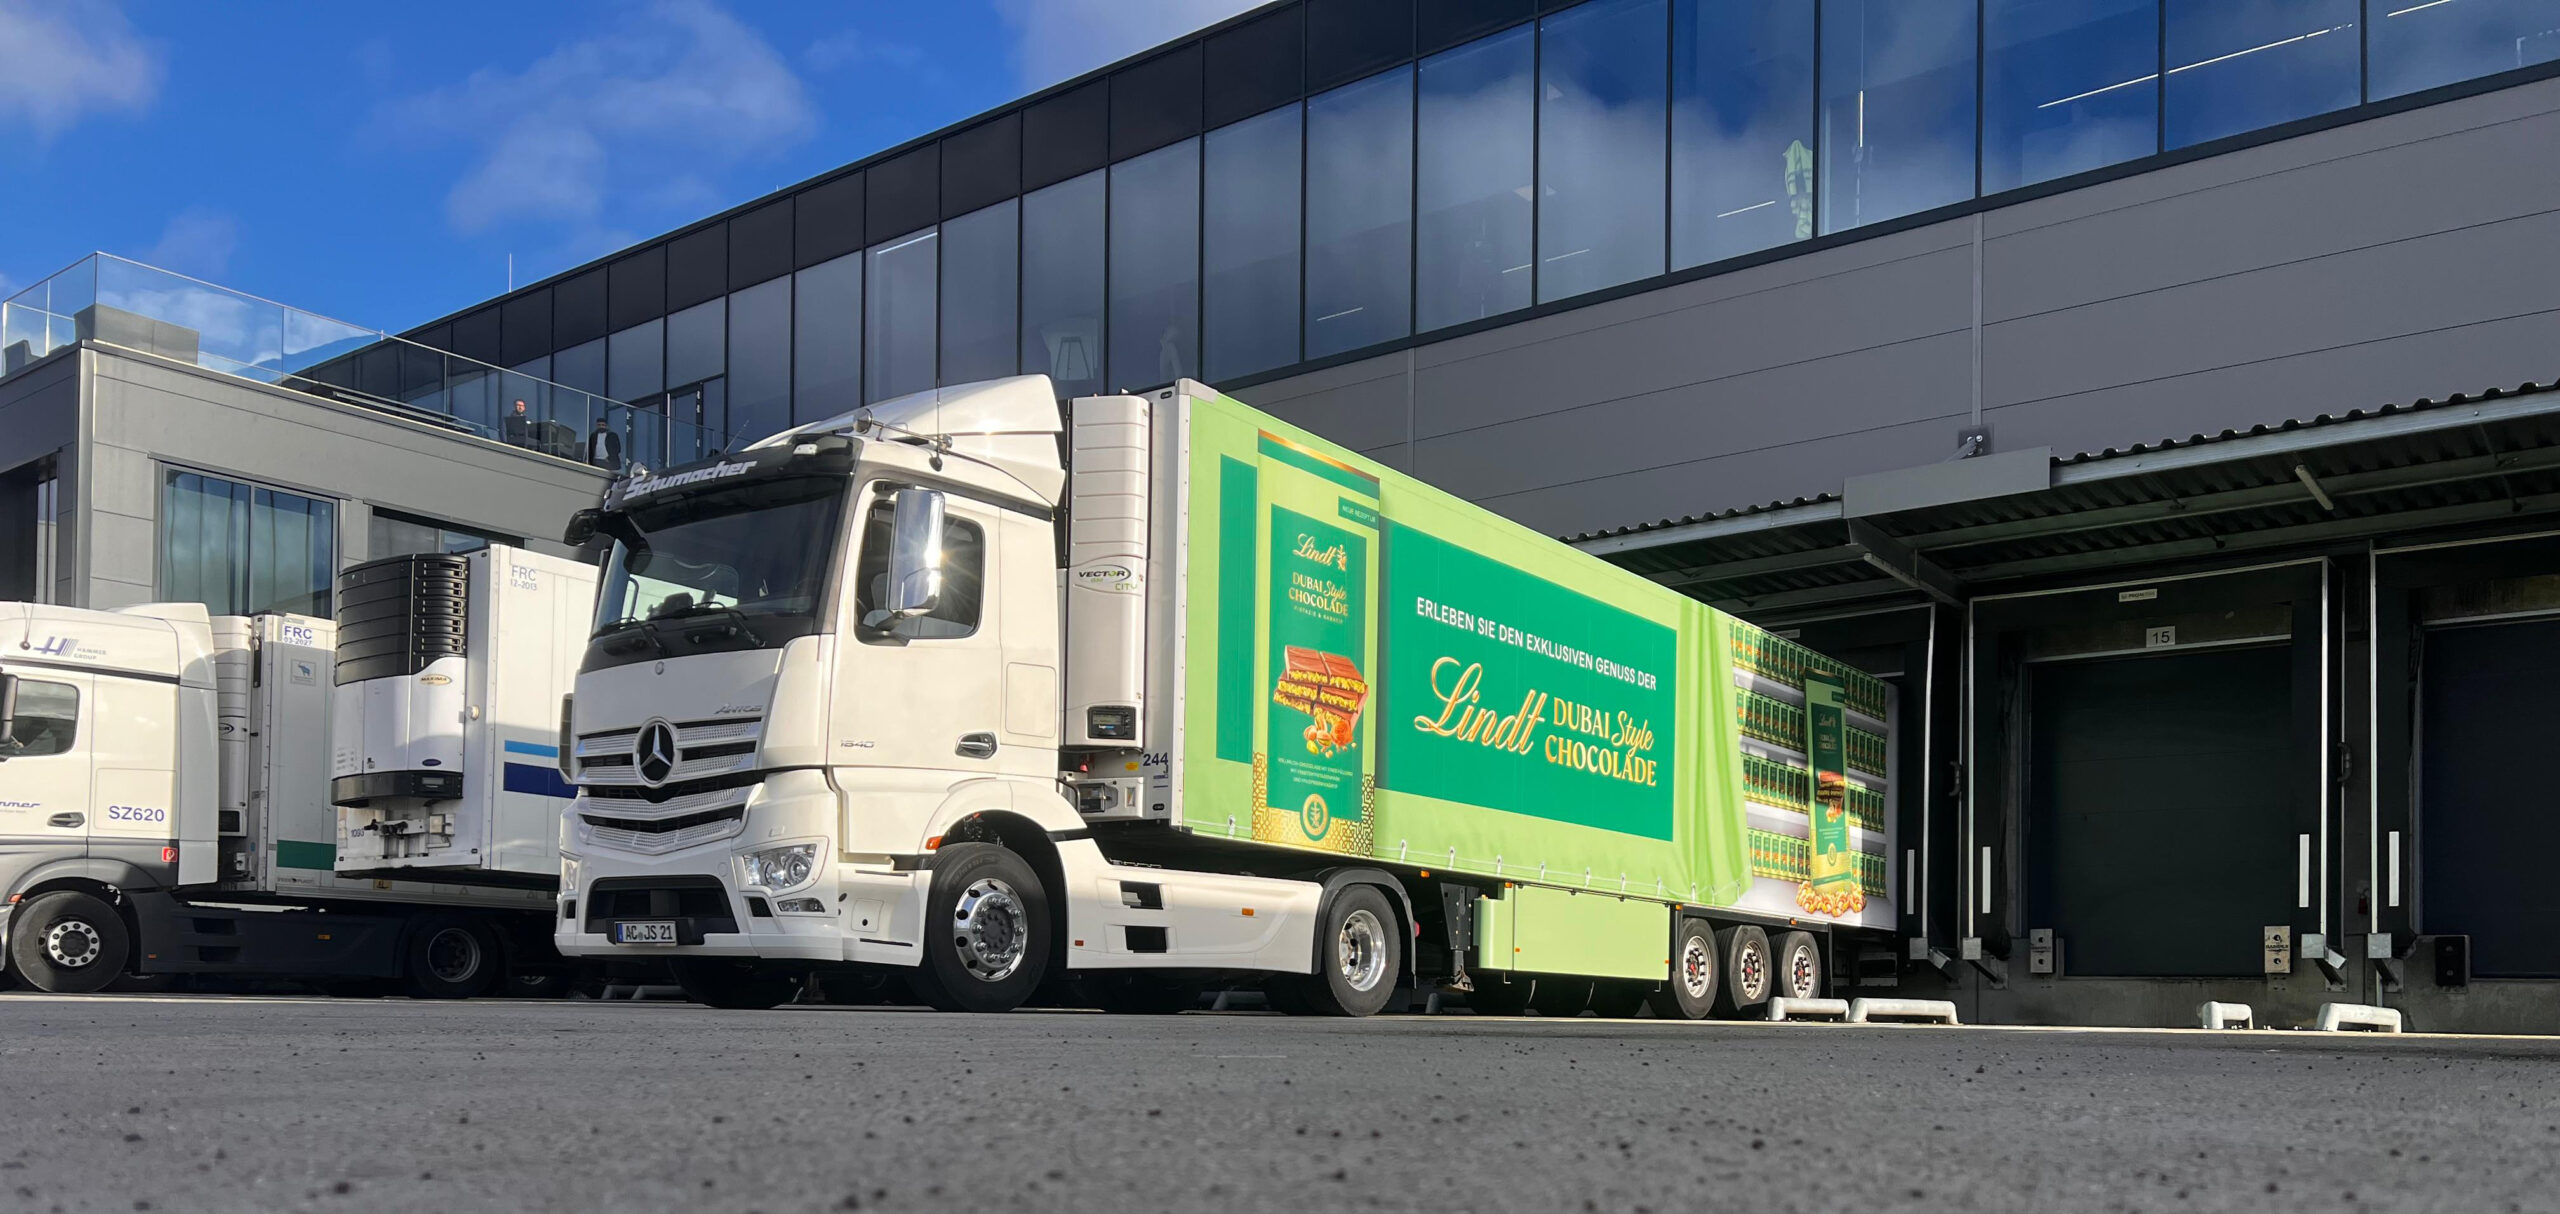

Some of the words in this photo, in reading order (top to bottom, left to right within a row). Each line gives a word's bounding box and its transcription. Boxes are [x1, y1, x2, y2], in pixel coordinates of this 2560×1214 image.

[622, 461, 757, 500] Schumacher
[1292, 533, 1337, 566] Lindt
[512, 565, 536, 581] FRC
[1078, 570, 1126, 578] VECTOR
[1292, 571, 1323, 593] DUBAI
[1323, 580, 1346, 600] Style
[1288, 587, 1349, 617] CHOCOLADE
[284, 625, 312, 639] FRC
[1417, 596, 1474, 632] ERLEBEN
[1478, 617, 1496, 639] SIE
[1499, 624, 1523, 647] DEN
[1526, 633, 1593, 670] EXKLUSIVEN
[1595, 657, 1635, 684] GENUSS
[1637, 670, 1657, 691] DER
[2152, 630, 2170, 644] 15
[1414, 656, 1548, 755] Lindt
[1553, 697, 1610, 739] DUBAI
[1611, 710, 1655, 757] Style
[1142, 752, 1168, 767] 244
[1545, 734, 1657, 787] CHOCOLADE
[108, 805, 165, 822] SZ620
[625, 925, 637, 940] AC
[644, 925, 657, 940] JS
[660, 925, 673, 940] 21
